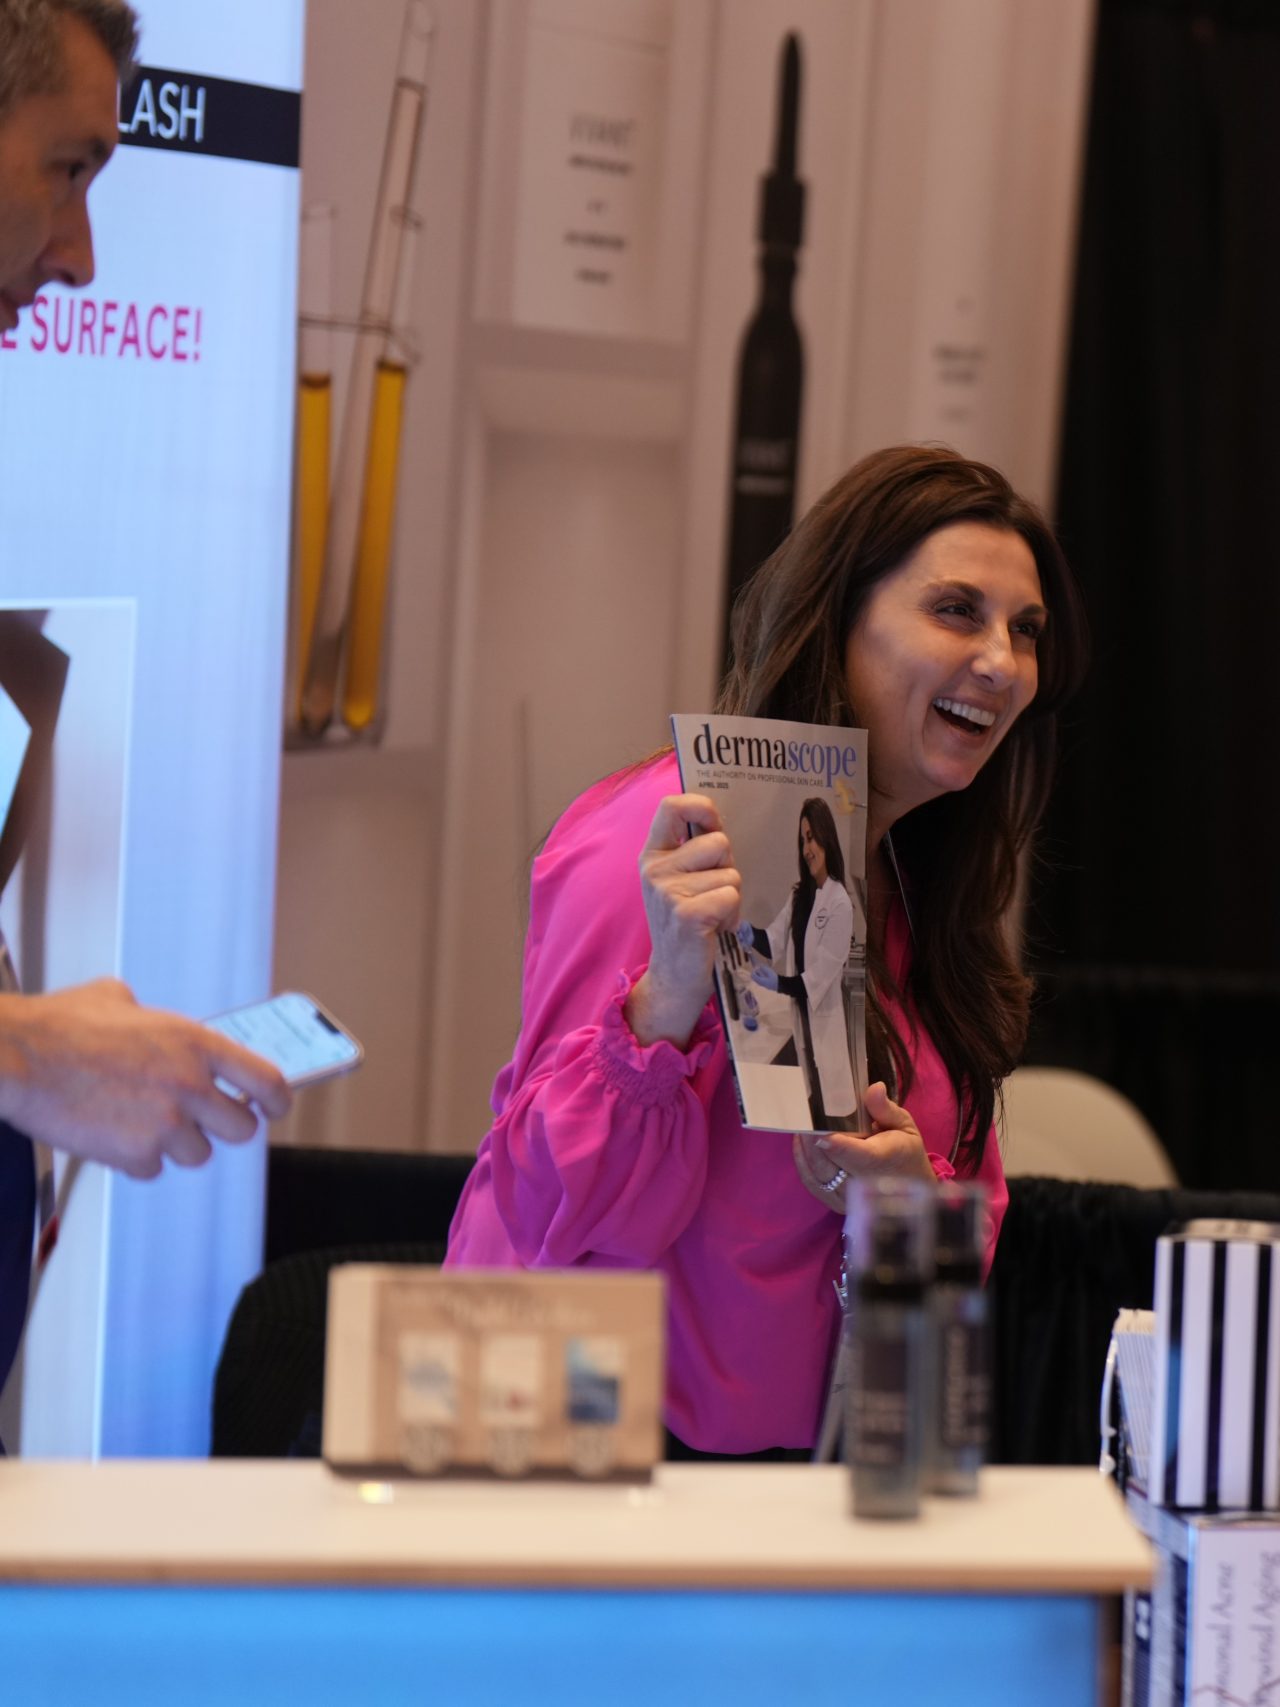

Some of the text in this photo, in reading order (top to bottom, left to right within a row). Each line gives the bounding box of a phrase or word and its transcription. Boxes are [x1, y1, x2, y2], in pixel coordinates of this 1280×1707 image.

[31, 295, 202, 362] SURFACE!
[693, 724, 856, 788] dermascope
[696, 769, 710, 778] THE
[713, 770, 746, 780] AUTHORITY
[757, 773, 797, 786] PROFESSIONAL
[809, 778, 824, 788] CARE
